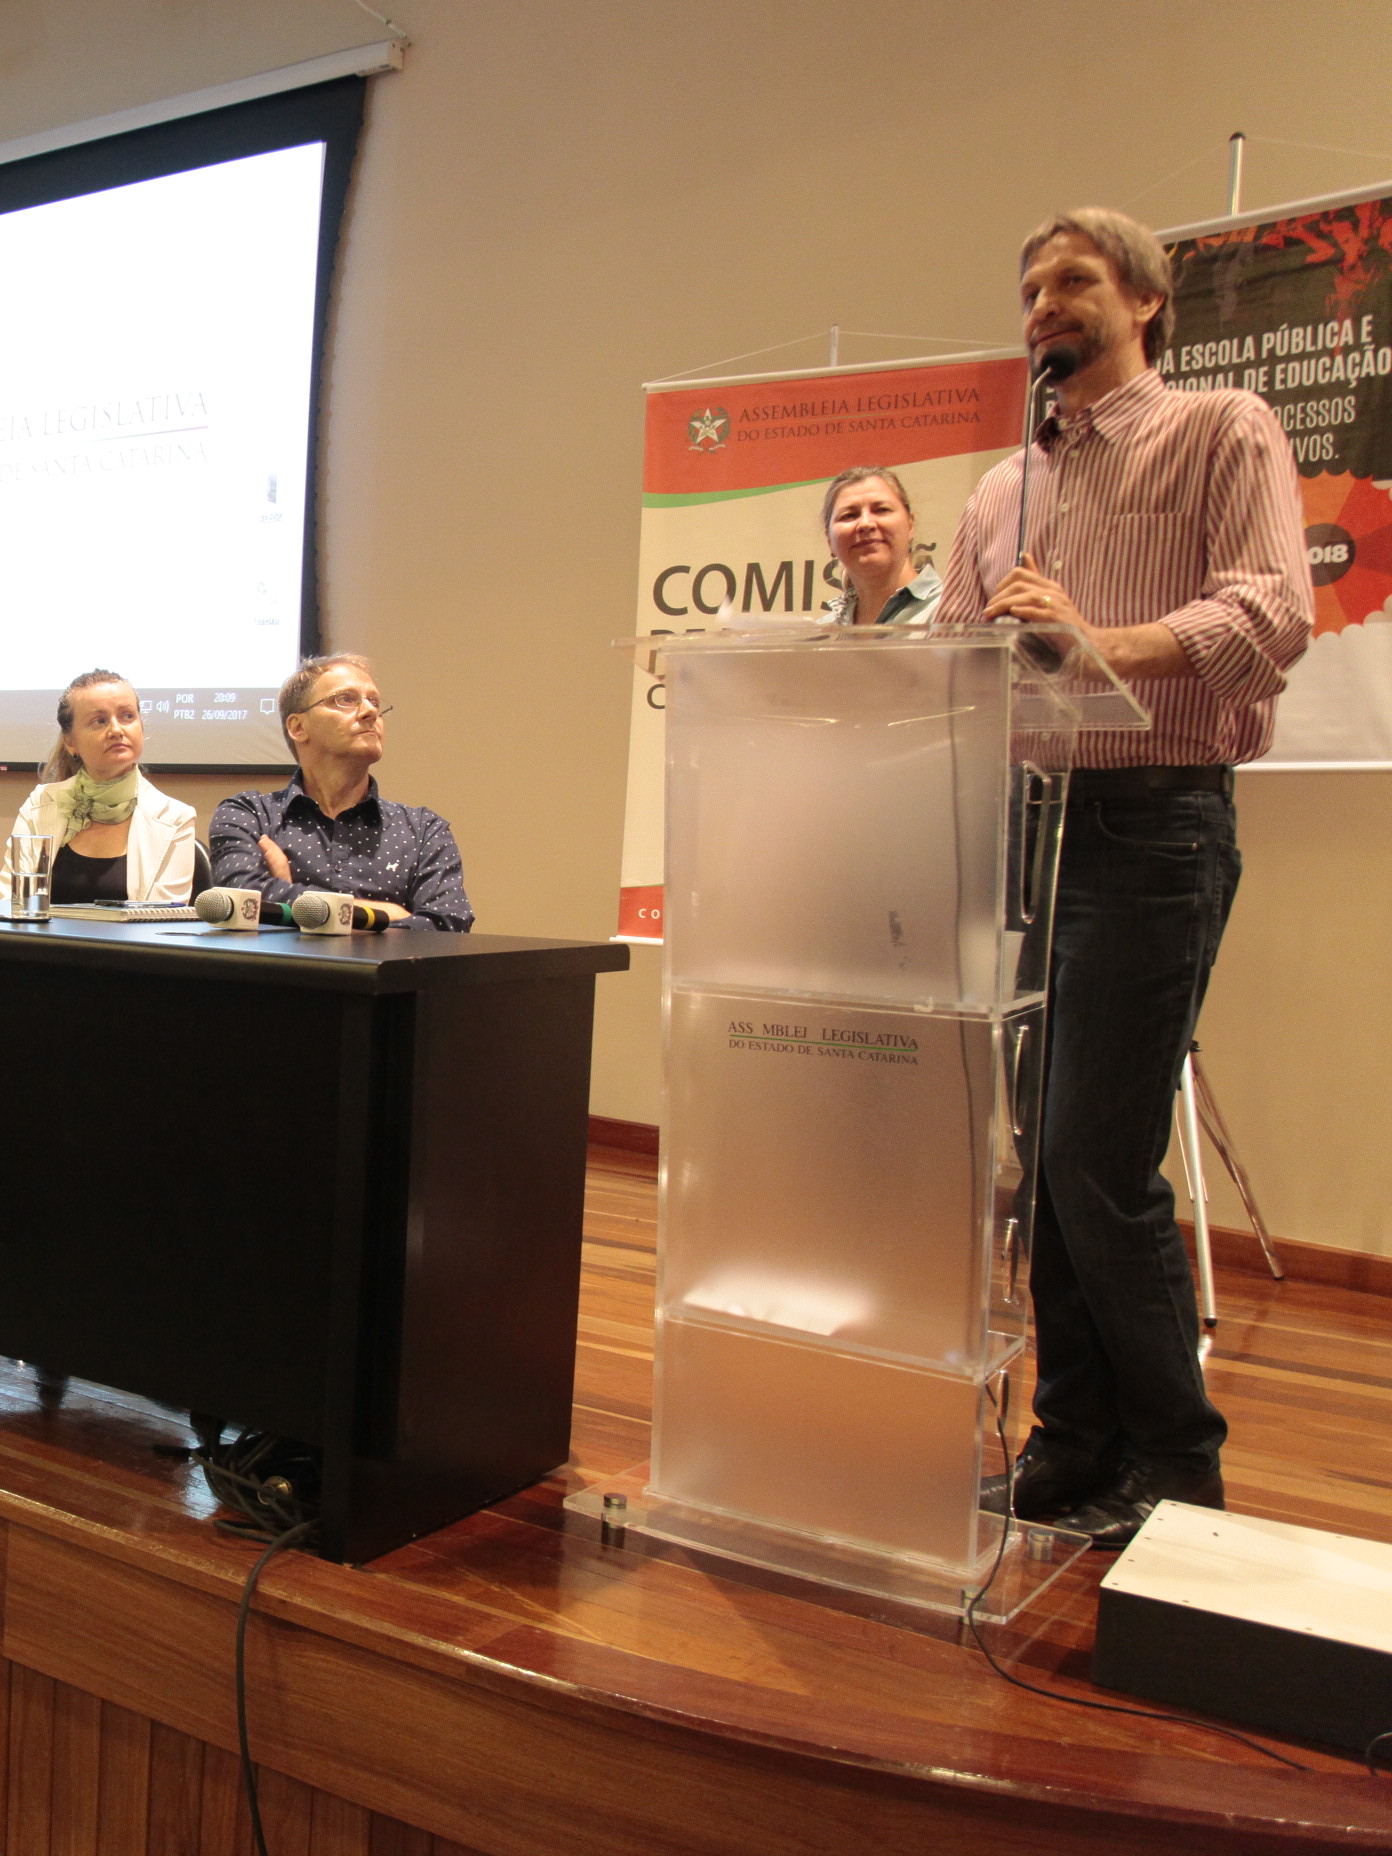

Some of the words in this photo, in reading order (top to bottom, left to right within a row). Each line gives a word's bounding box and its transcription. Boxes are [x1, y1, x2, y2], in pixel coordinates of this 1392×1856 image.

[1179, 334, 1255, 372] ESCOLA
[1261, 317, 1355, 360] PÚBLICA
[1360, 313, 1374, 344] E
[1243, 366, 1269, 394] DE
[1274, 343, 1392, 390] EDUCAÇÃO
[42, 391, 210, 436] LEGISLATIVA
[738, 398, 850, 423] ASSEMBLEIA
[856, 387, 982, 413] LEGISLATIVA
[737, 429, 760, 442] DO
[764, 424, 821, 441] ESTADO
[825, 421, 844, 435] DE
[848, 417, 897, 433] SANTA
[901, 411, 981, 428] CATARINA
[1307, 544, 1349, 565] 018
[175, 693, 194, 704] POR
[213, 692, 236, 703] 20:09
[201, 709, 248, 720] 26/09/2017
[729, 1039, 745, 1050] DO
[748, 1040, 795, 1054] ESTADO
[798, 1045, 812, 1056] DE
[817, 1047, 855, 1060] SANTA
[858, 1051, 919, 1066] CATARINA
[822, 1028, 919, 1050] LEGISLATIVA
